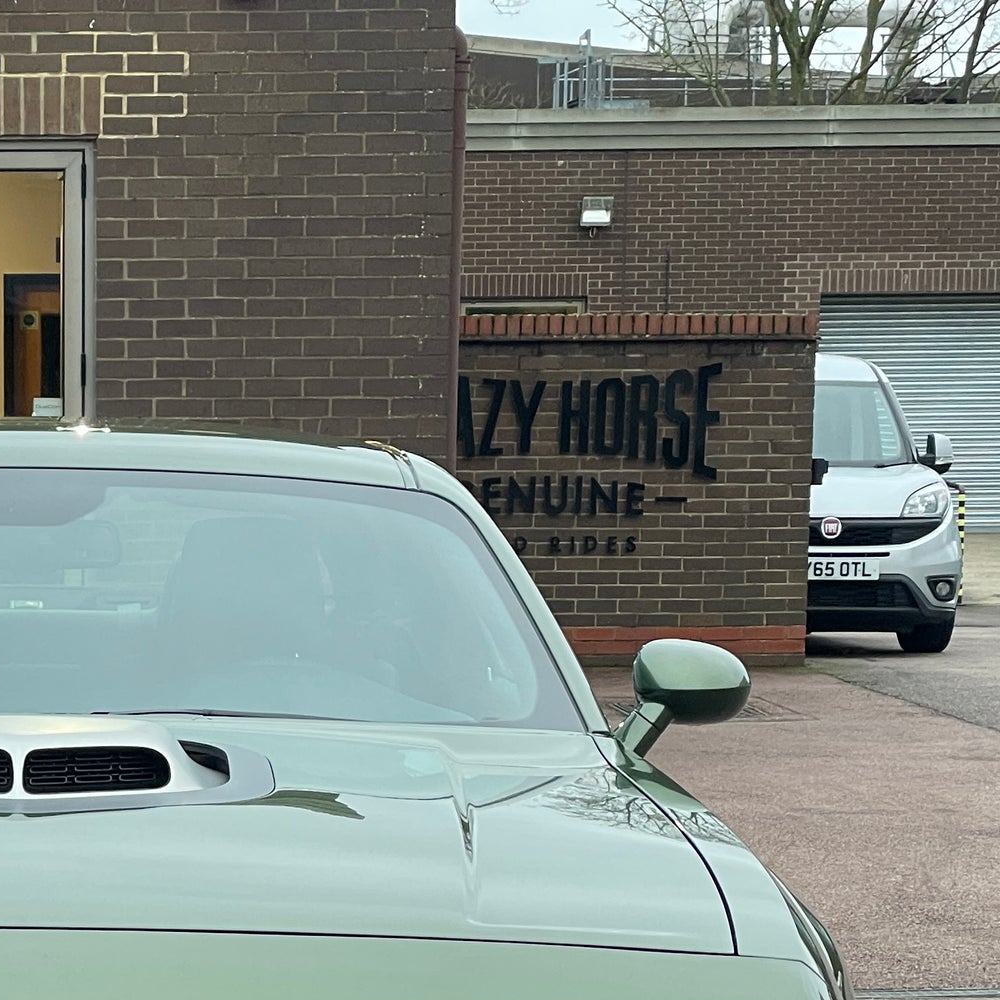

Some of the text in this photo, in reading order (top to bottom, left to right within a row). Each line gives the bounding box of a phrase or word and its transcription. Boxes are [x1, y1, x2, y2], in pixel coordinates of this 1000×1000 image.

[559, 362, 723, 481] HORSE
[461, 475, 645, 516] ENUINE
[550, 535, 637, 553] RIDES
[808, 561, 872, 577] 65 OTL
